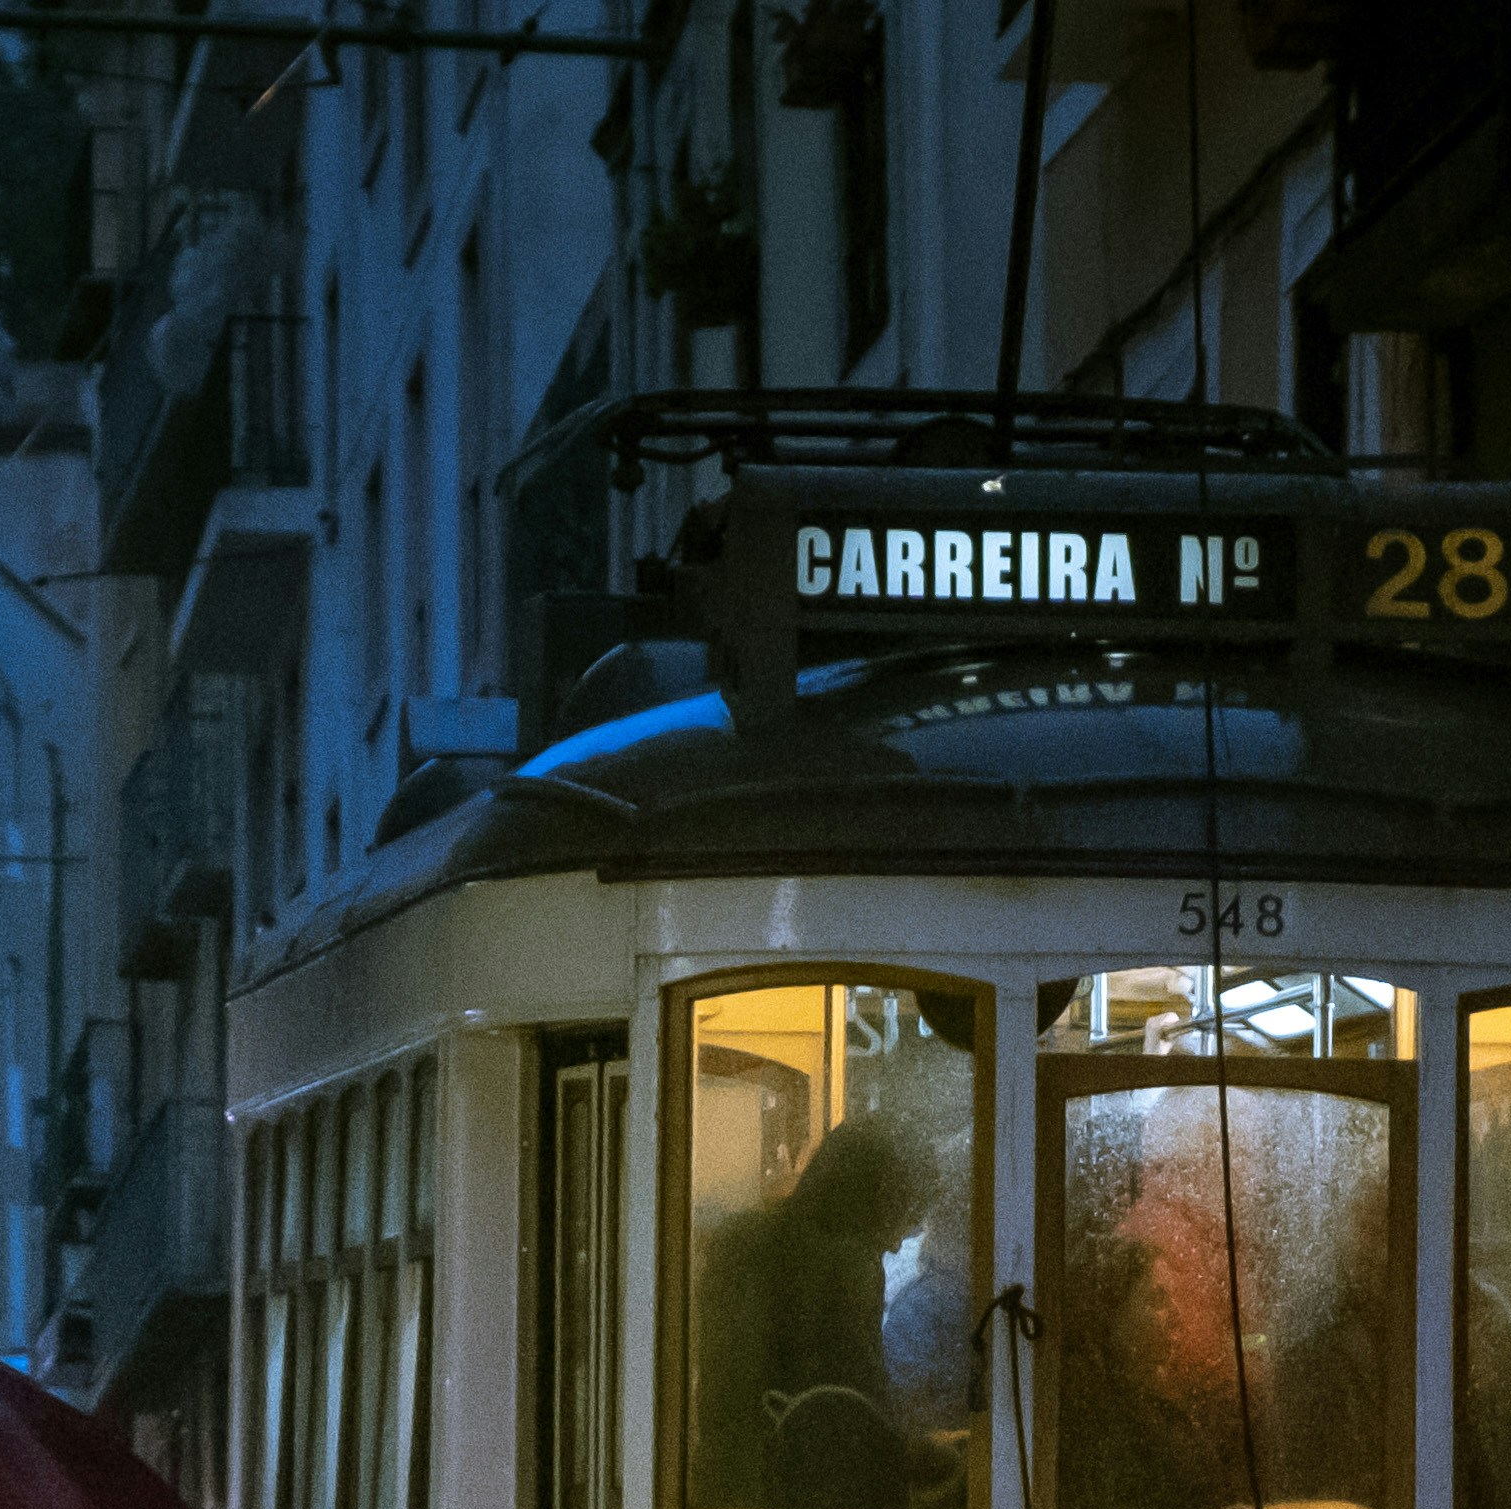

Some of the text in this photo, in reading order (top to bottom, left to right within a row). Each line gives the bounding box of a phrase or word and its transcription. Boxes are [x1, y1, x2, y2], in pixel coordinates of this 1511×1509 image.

[796, 525, 1260, 605] CARREIRA Nº
[1178, 893, 1285, 937] 548
